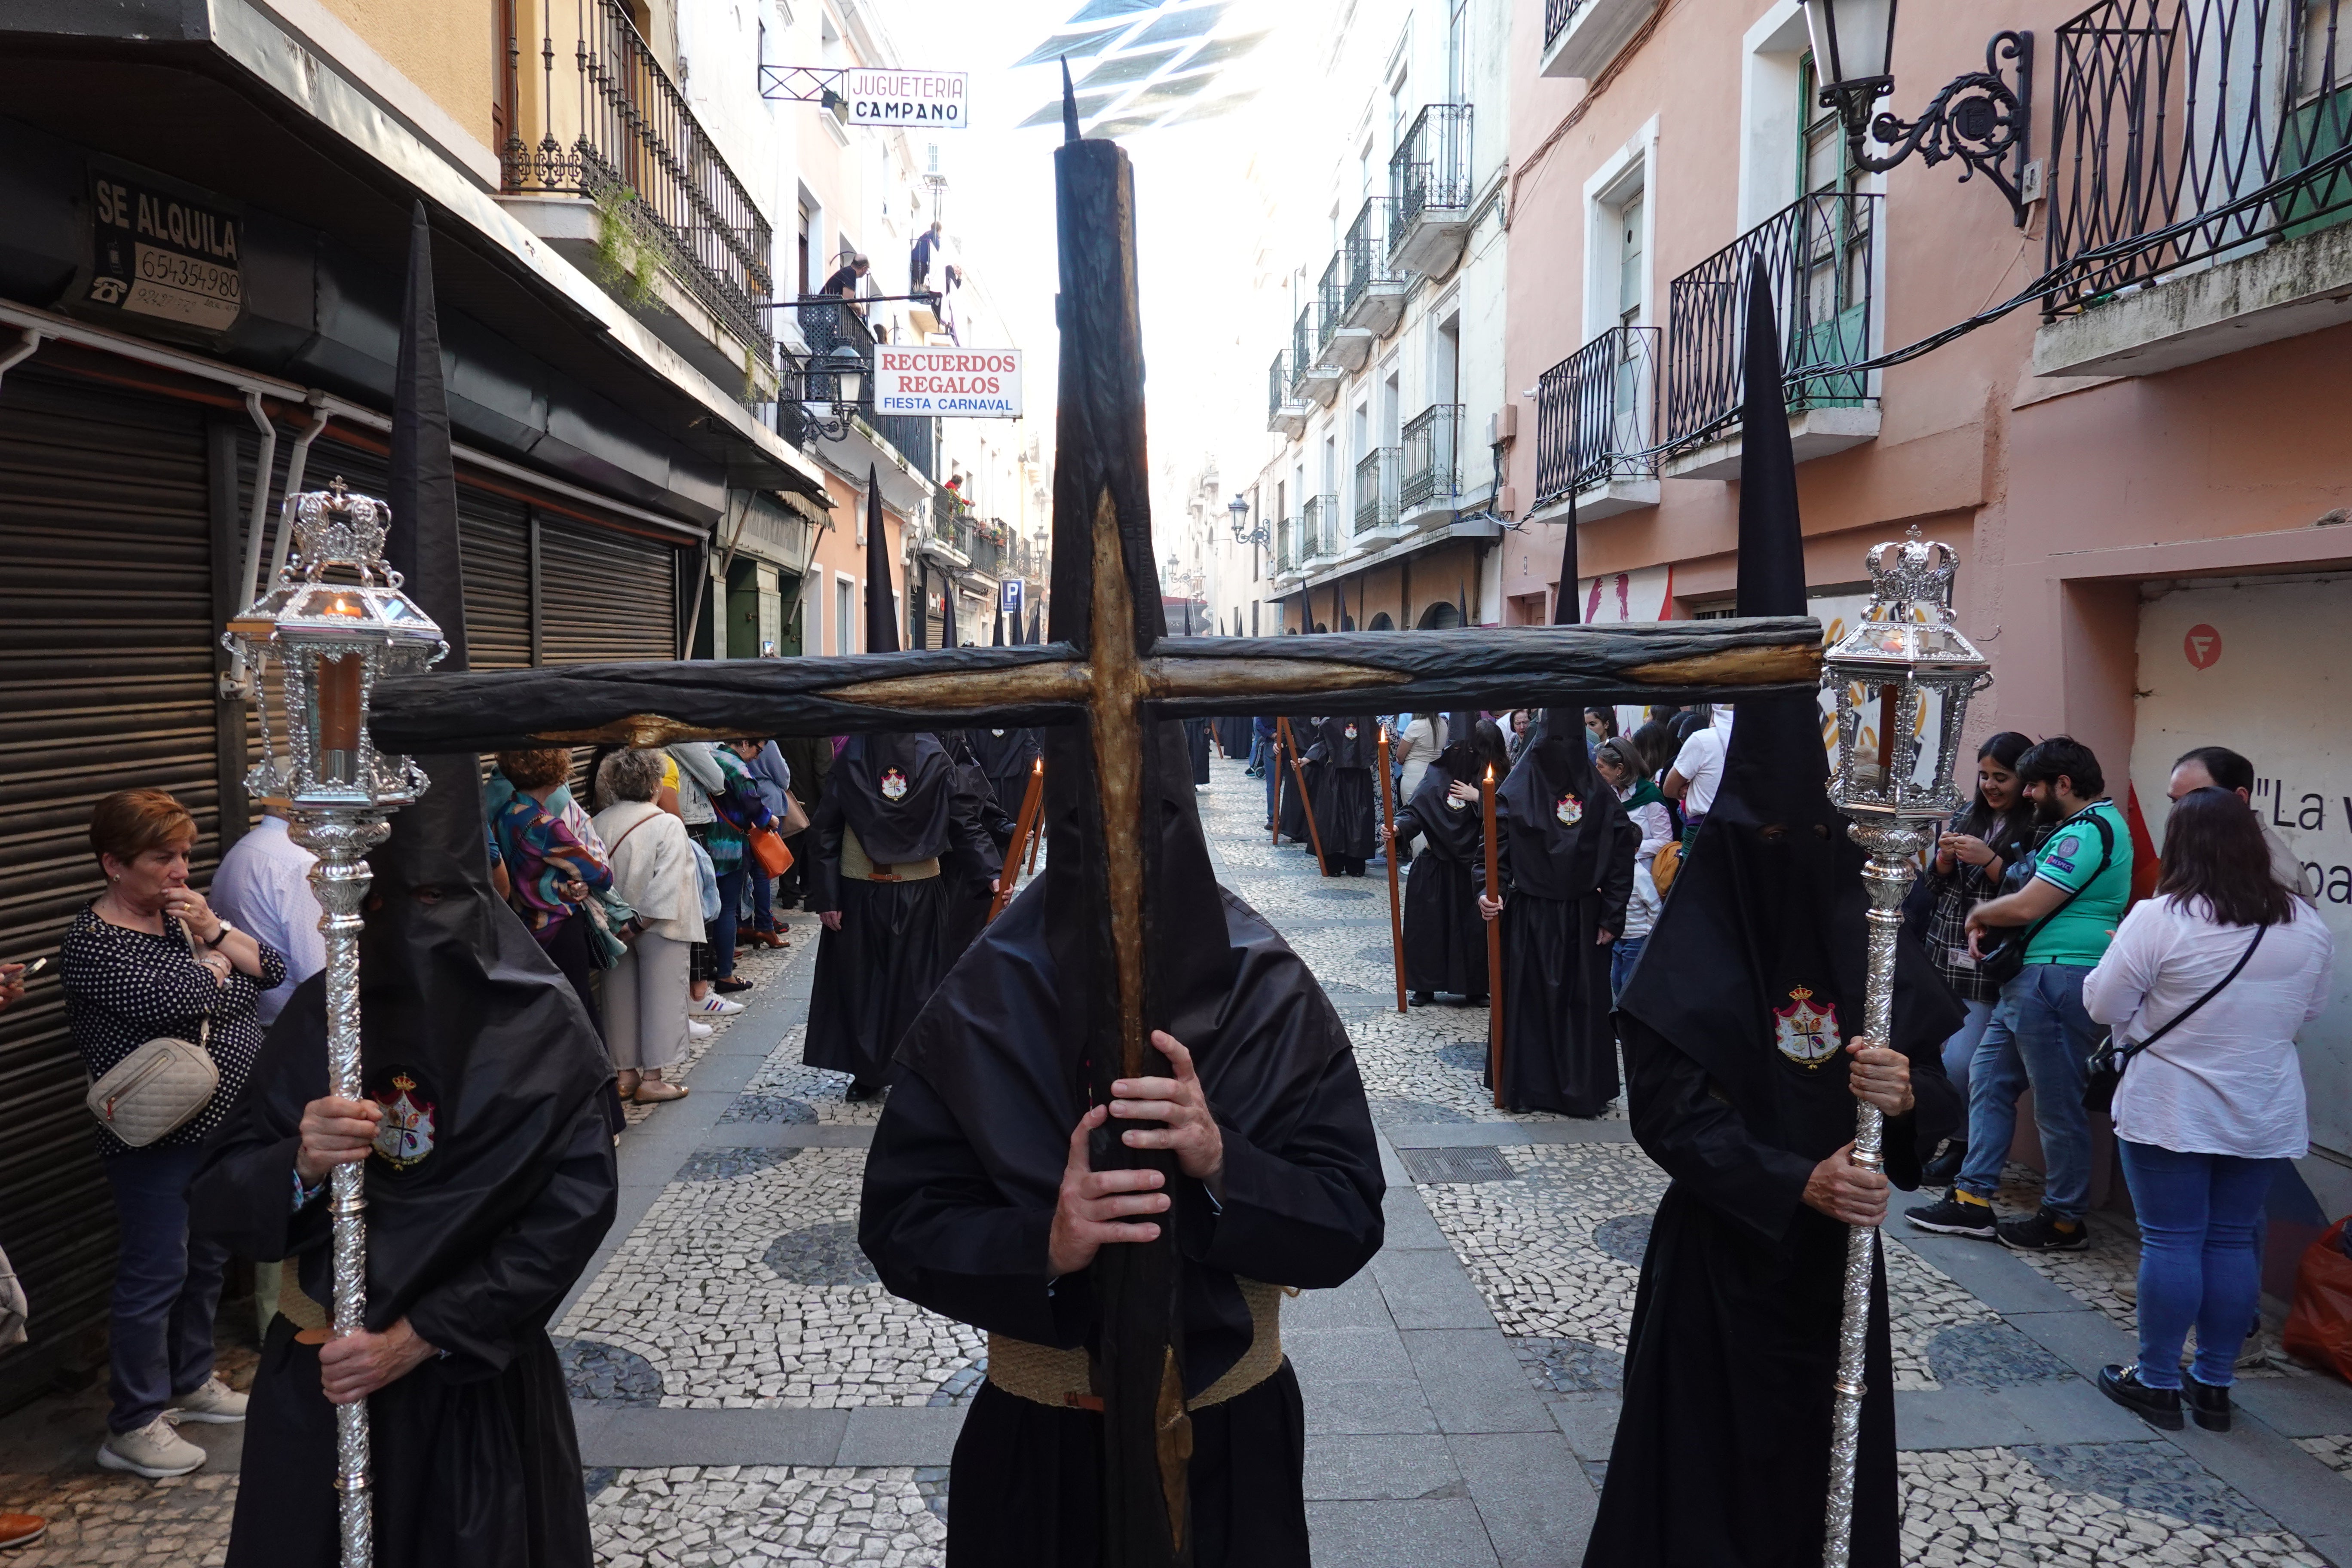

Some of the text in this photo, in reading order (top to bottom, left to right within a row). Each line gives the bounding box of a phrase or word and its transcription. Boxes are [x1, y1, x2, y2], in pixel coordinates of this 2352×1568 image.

[853, 75, 963, 98] JUGUETERIA
[856, 101, 958, 120] CAMPANO
[97, 180, 237, 260] SE ALQUILA
[142, 251, 239, 297] 654354980
[882, 354, 1015, 373] RECUERDOS
[898, 376, 1000, 394] REGALOS
[884, 398, 1013, 410] FIESTA CARNAVAL
[1007, 583, 1019, 602] P
